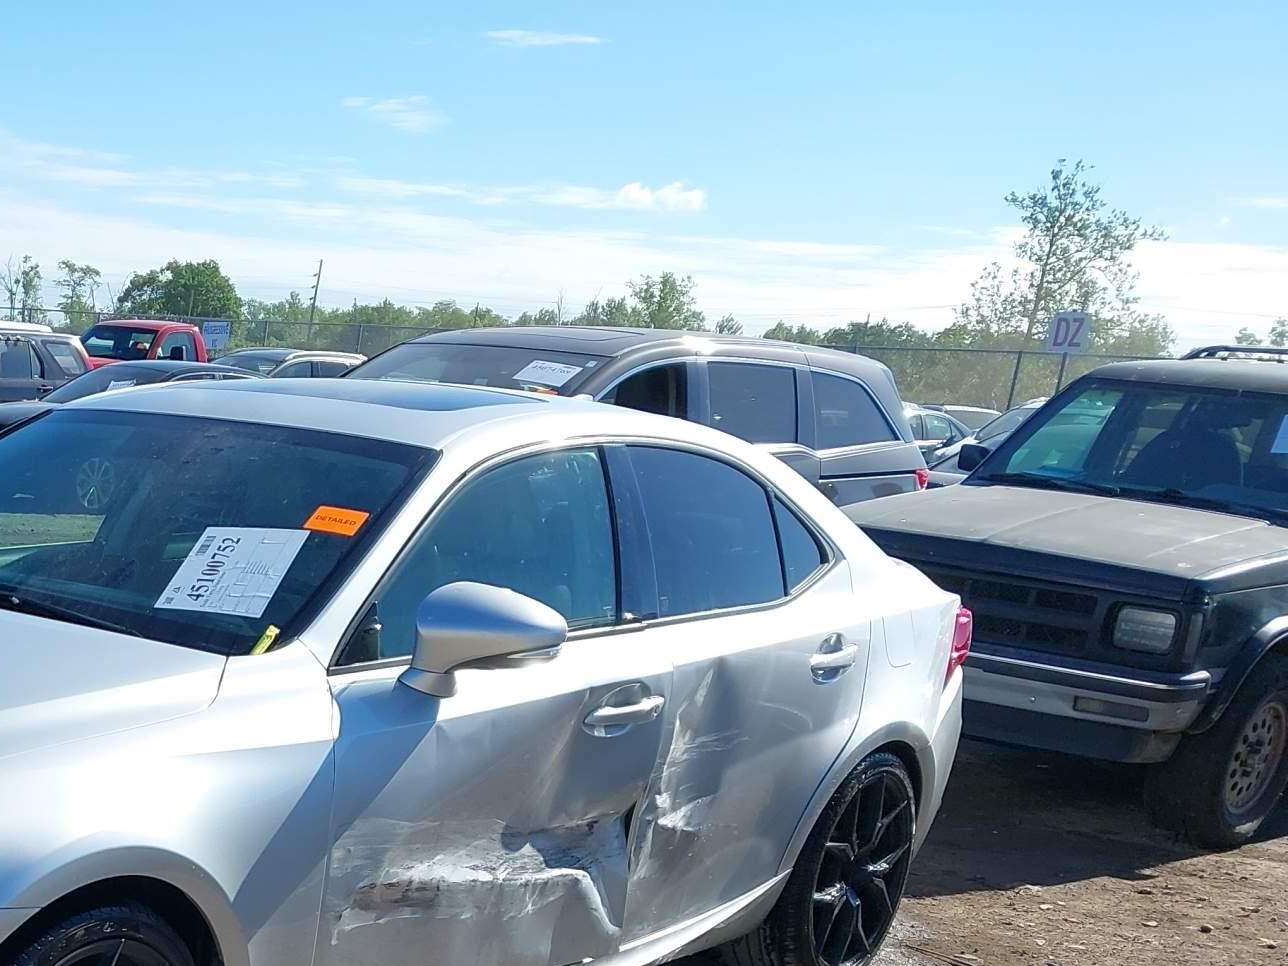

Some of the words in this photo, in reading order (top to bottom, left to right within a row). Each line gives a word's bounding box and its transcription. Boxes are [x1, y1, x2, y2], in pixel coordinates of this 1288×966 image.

[1052, 317, 1085, 347] DZ
[315, 515, 358, 526] DETAILED
[186, 536, 241, 602] 45100752
